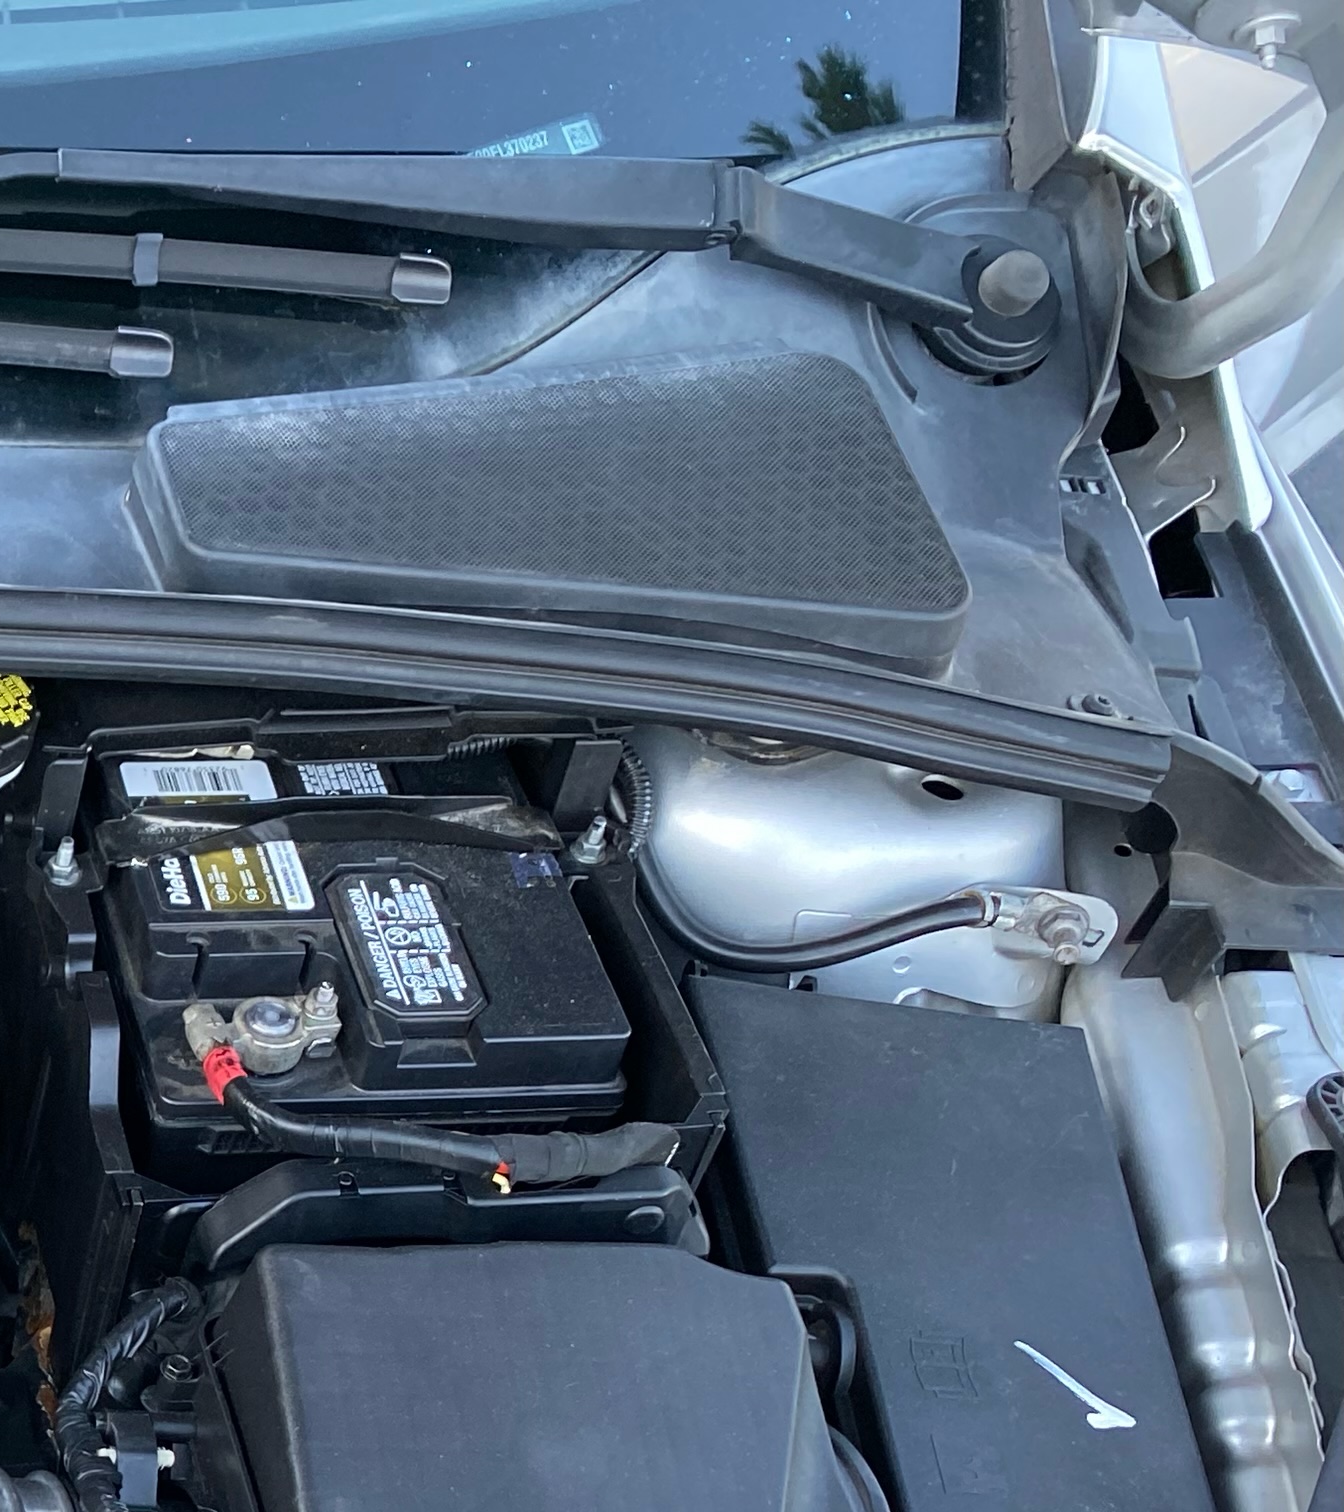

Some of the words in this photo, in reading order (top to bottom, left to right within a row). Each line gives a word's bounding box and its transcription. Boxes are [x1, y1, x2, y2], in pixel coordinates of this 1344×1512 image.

[245, 888, 260, 900] 95
[348, 888, 376, 930] POISON
[368, 941, 398, 988] DANGER
